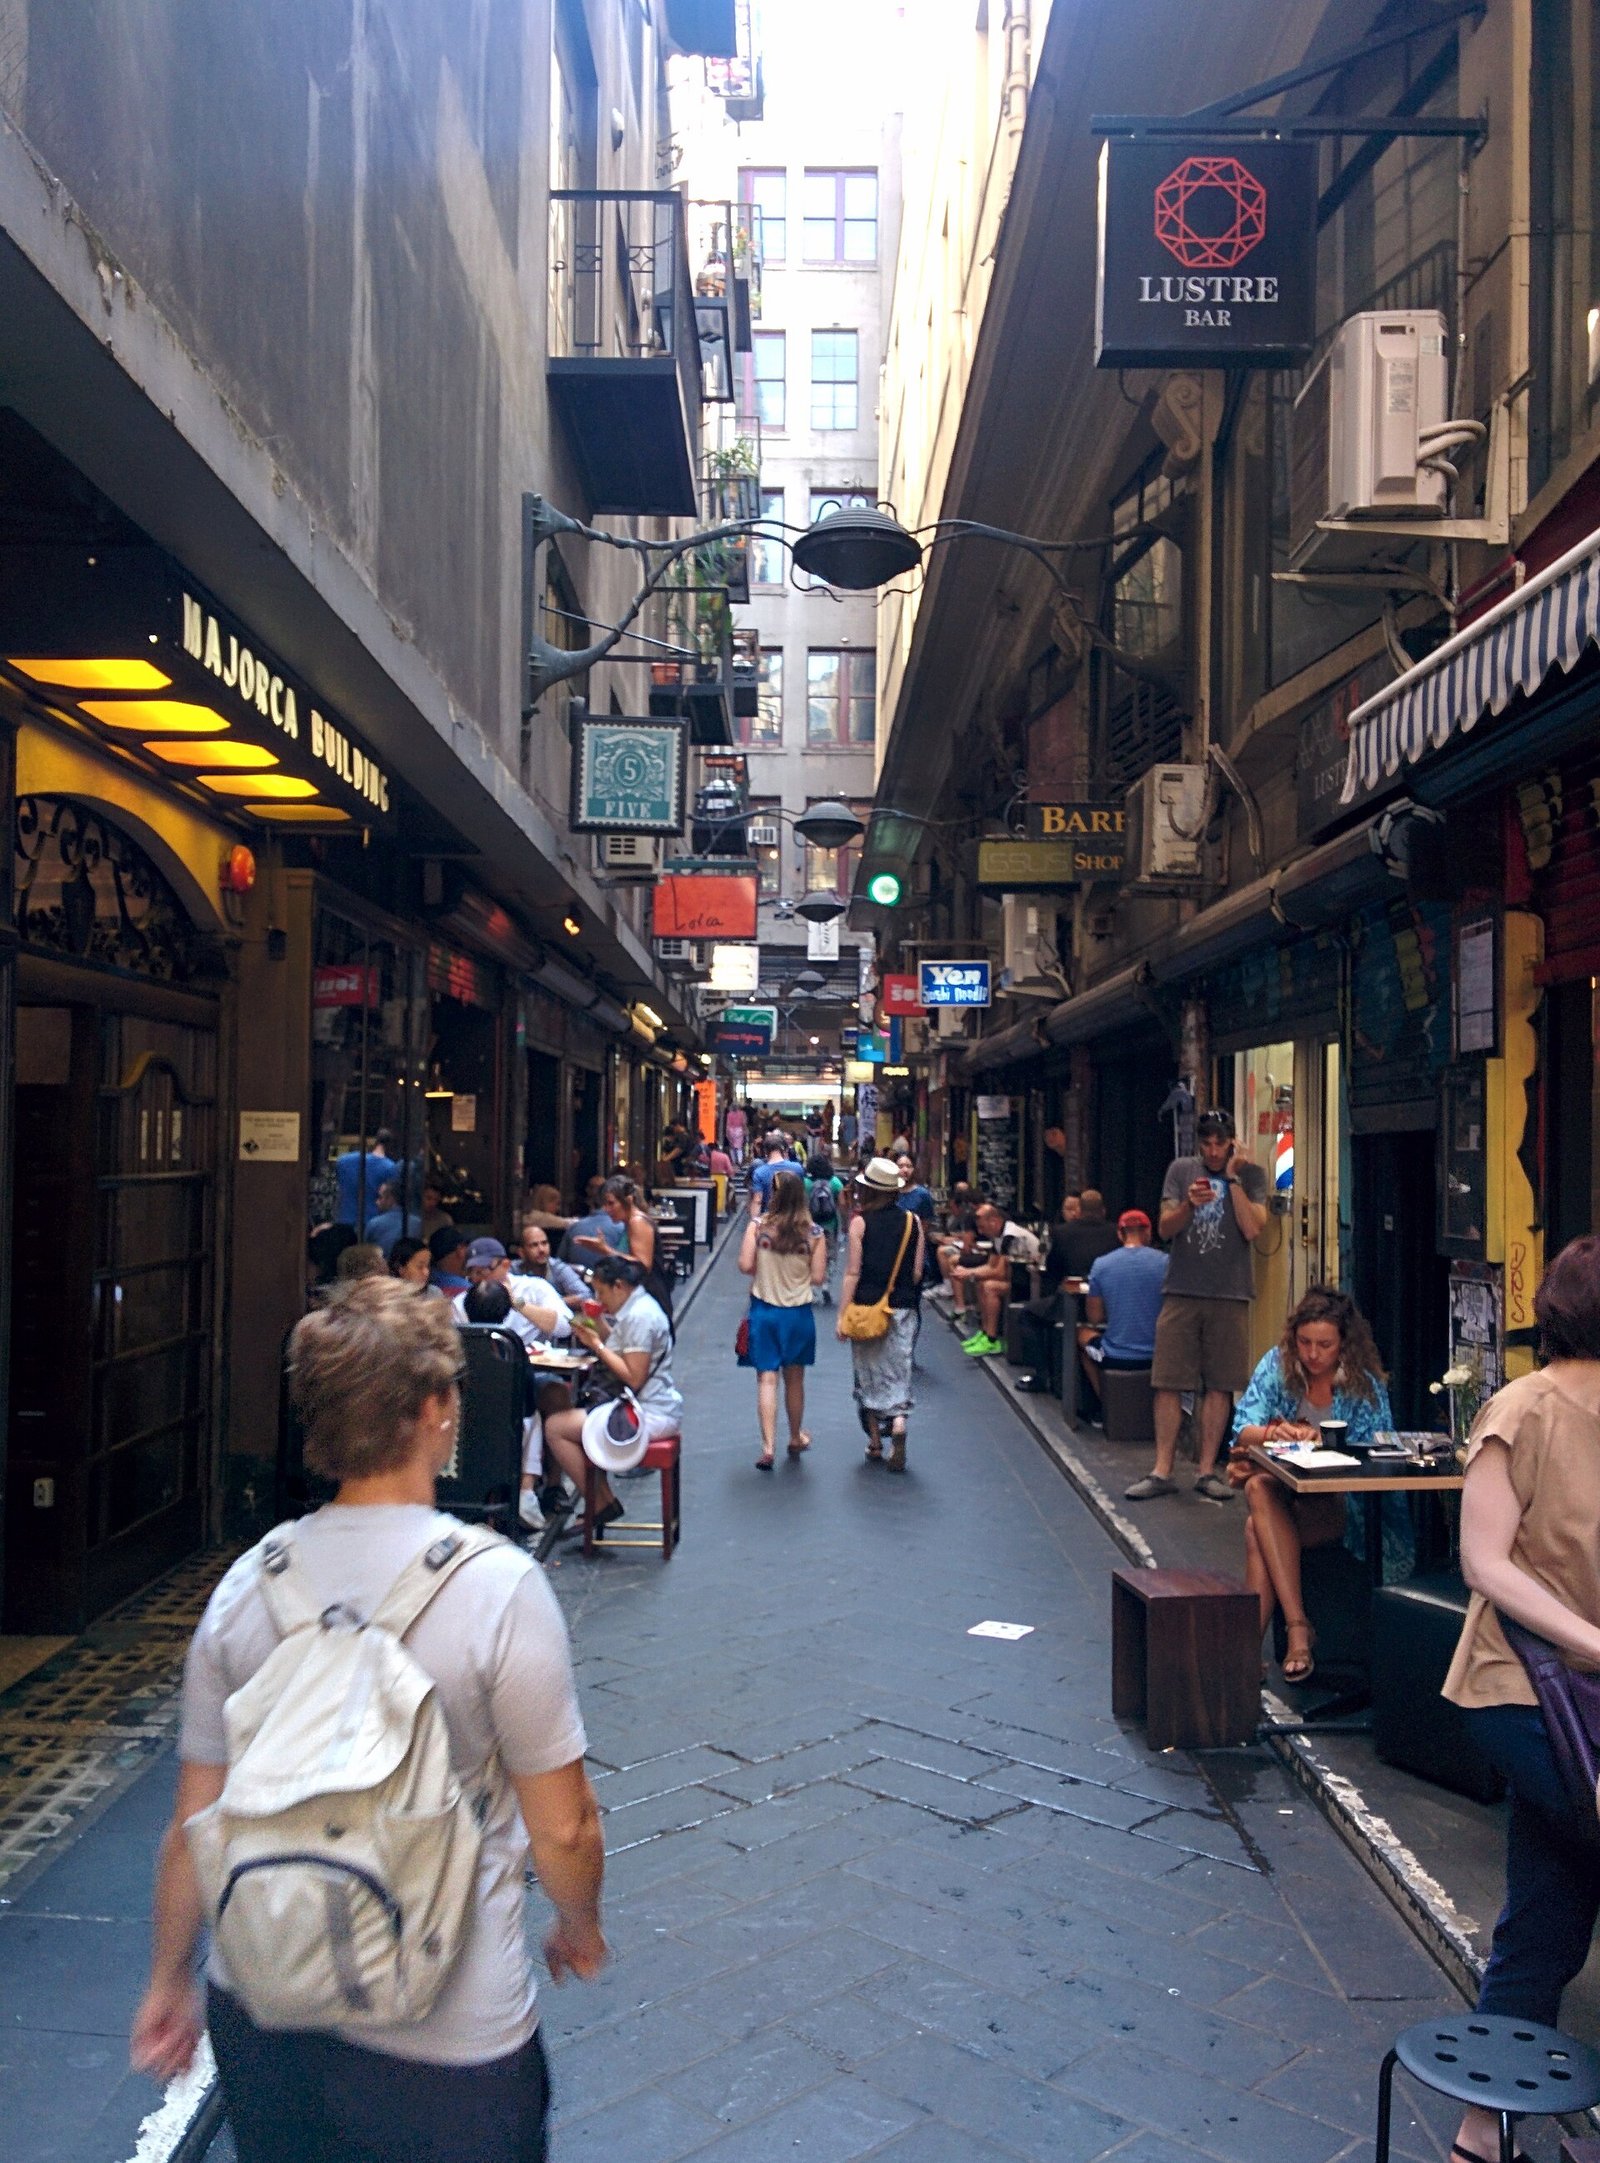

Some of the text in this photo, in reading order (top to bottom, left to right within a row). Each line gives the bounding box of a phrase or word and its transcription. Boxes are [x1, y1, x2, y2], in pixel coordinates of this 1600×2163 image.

[1138, 276, 1279, 303] LUSTRE
[1184, 309, 1232, 327] BAR
[182, 592, 390, 813] MAJORCA BUILDING
[624, 758, 637, 781] 5
[604, 803, 651, 818] FIVE
[1074, 852, 1124, 870] SHOP
[928, 966, 982, 986] Yen
